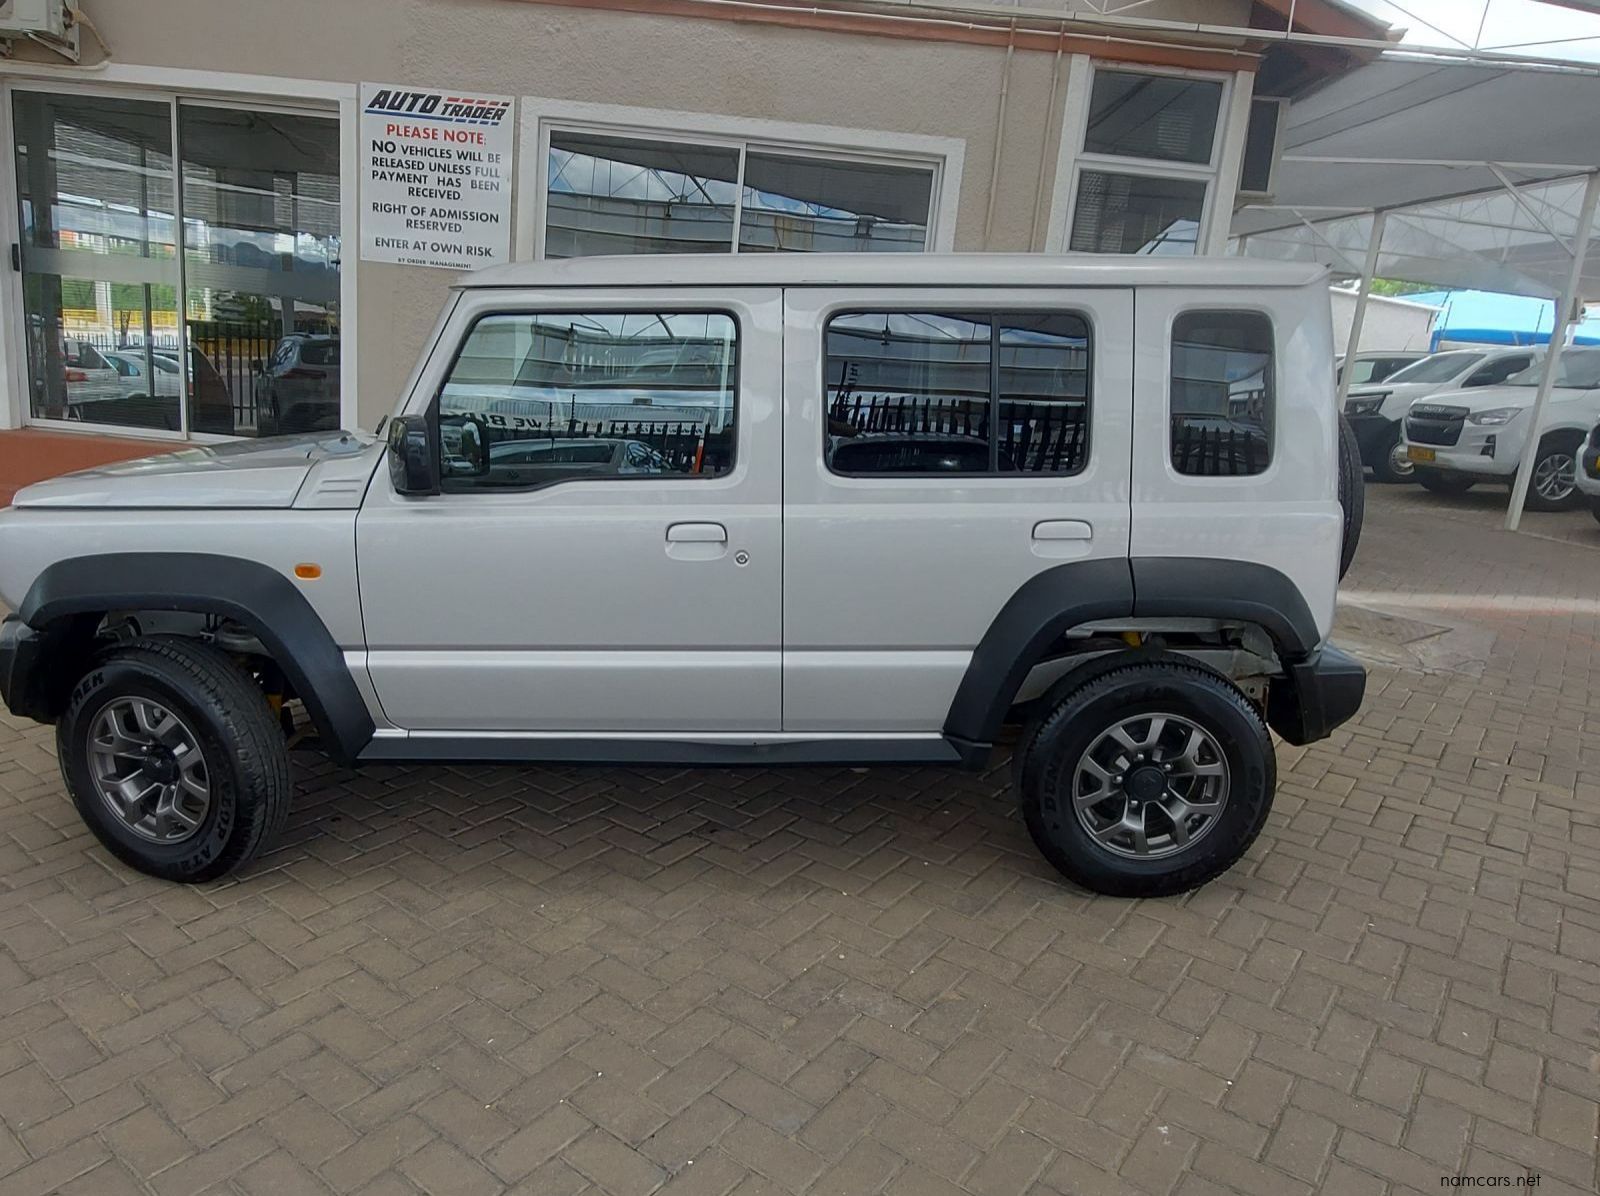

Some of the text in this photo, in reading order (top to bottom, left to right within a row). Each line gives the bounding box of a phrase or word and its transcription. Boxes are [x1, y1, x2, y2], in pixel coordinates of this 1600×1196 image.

[368, 90, 506, 121] AUTO TRADER
[386, 124, 438, 141] PLEASE
[372, 140, 501, 163] NO VEHICLES WILL BE
[372, 157, 500, 178] RELEASED UNLESS FULL
[372, 170, 500, 192] PAYMENT HAS BEEN
[372, 202, 499, 224] RIGHT OF ADMISSION
[375, 237, 409, 250] ENTER
[413, 241, 427, 251] AT
[431, 242, 462, 254] OWN
[429, 260, 472, 269] MANAGEMENT
